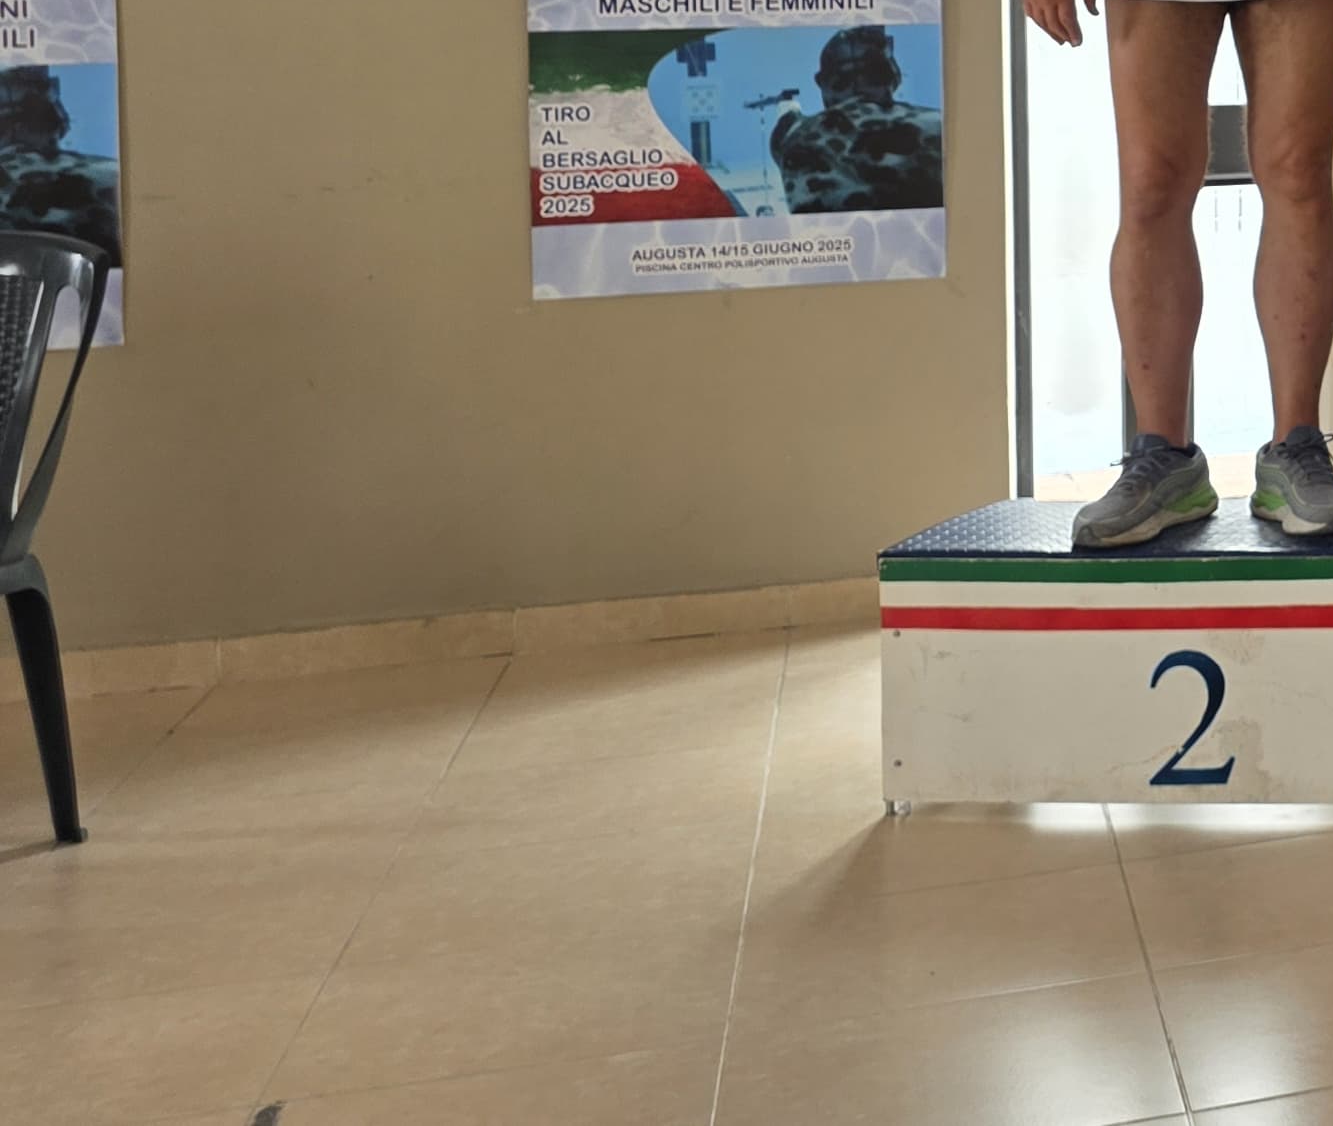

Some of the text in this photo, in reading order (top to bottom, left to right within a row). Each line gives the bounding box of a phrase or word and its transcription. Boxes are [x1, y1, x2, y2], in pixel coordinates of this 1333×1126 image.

[541, 106, 591, 123] TIRO
[541, 130, 569, 146] AL
[542, 149, 663, 169] BERSAGLIO
[541, 171, 676, 193] SUBACQUEO
[543, 197, 591, 215] 2025
[632, 238, 851, 262] AUGUSTA 14/15 GIUGNO 2025
[680, 261, 721, 271] CENTRO
[725, 257, 798, 269] POLISPORTIVO
[801, 254, 849, 265] AUGUSTA
[1149, 650, 1236, 786] 2
